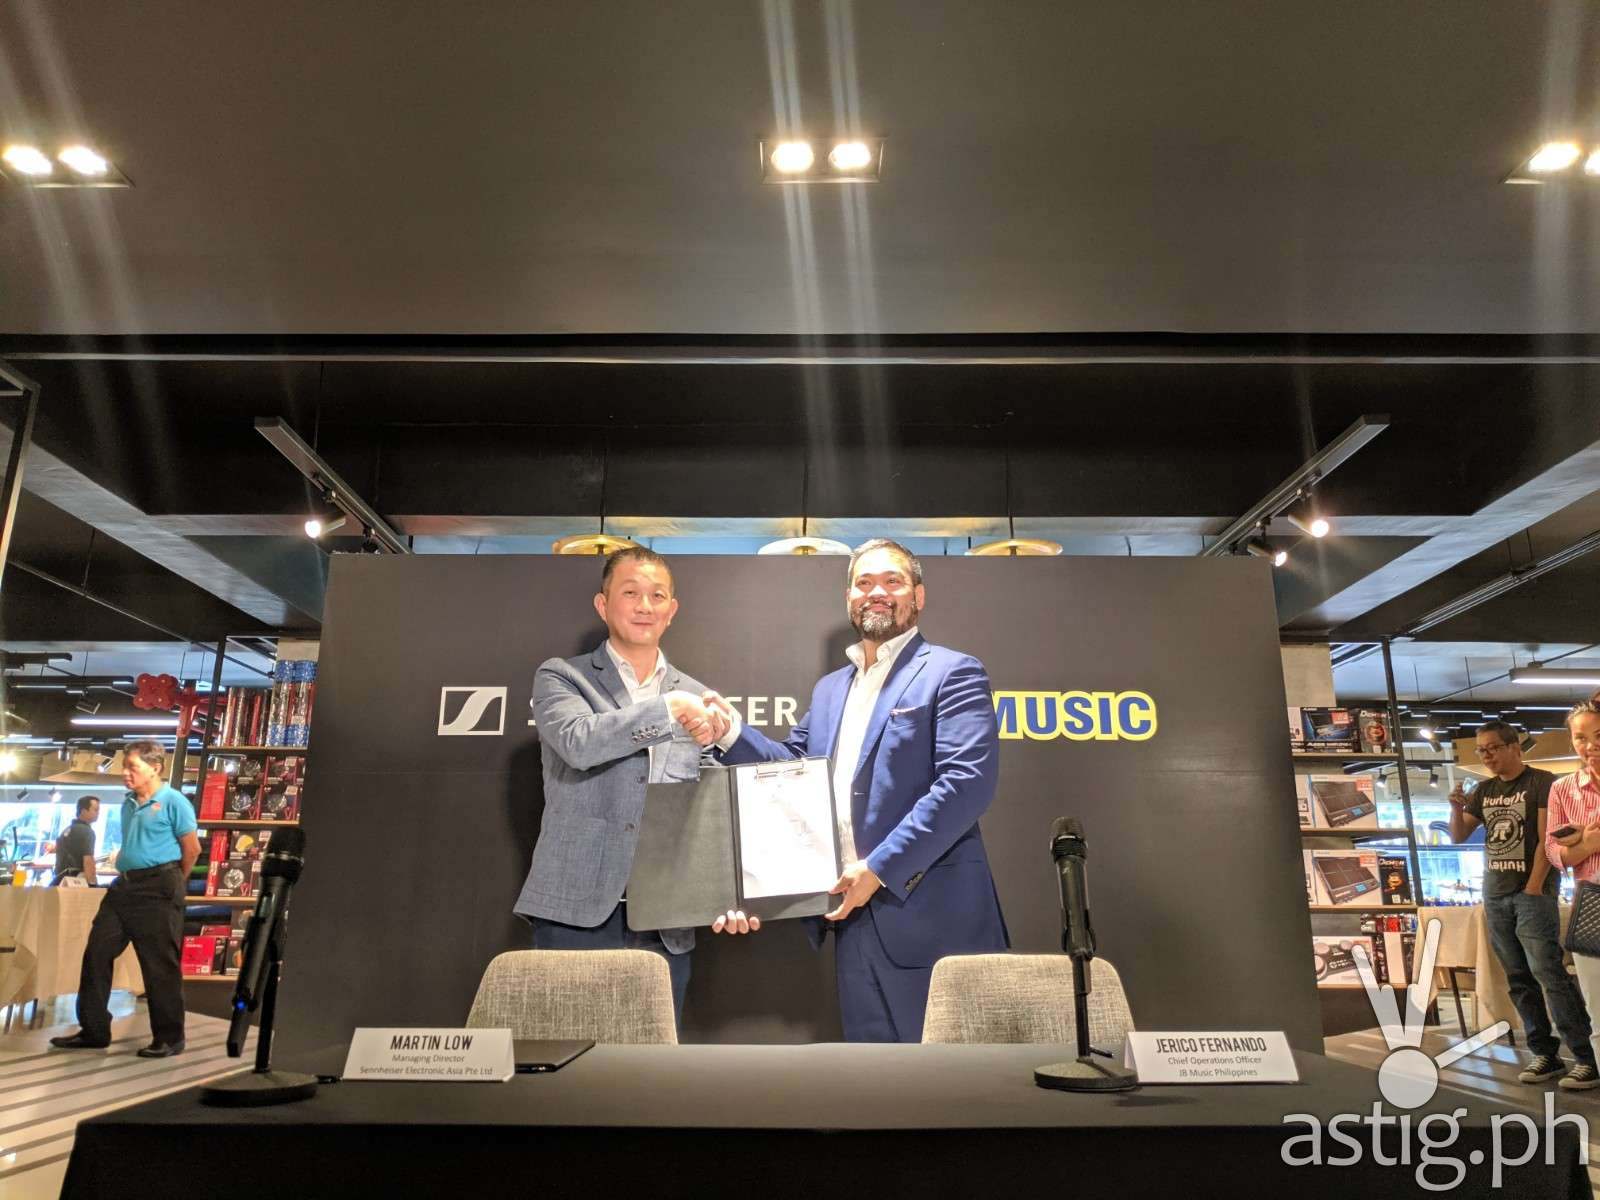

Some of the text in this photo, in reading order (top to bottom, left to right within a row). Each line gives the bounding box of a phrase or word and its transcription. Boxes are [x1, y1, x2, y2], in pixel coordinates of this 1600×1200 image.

[993, 692, 1156, 740] MUSIC
[1483, 794, 1516, 807] Hurley
[390, 1035, 473, 1050] MARTIN LOW
[1156, 1037, 1267, 1053] JERICO FERNANDO
[392, 1054, 465, 1063] Managing Director
[1168, 1055, 1262, 1066] Chief Operations Officer
[360, 1066, 493, 1076] Sennheiser Electronic Asia Pte Ltd
[1190, 1068, 1213, 1077] Music
[1214, 1068, 1258, 1078] Philippines
